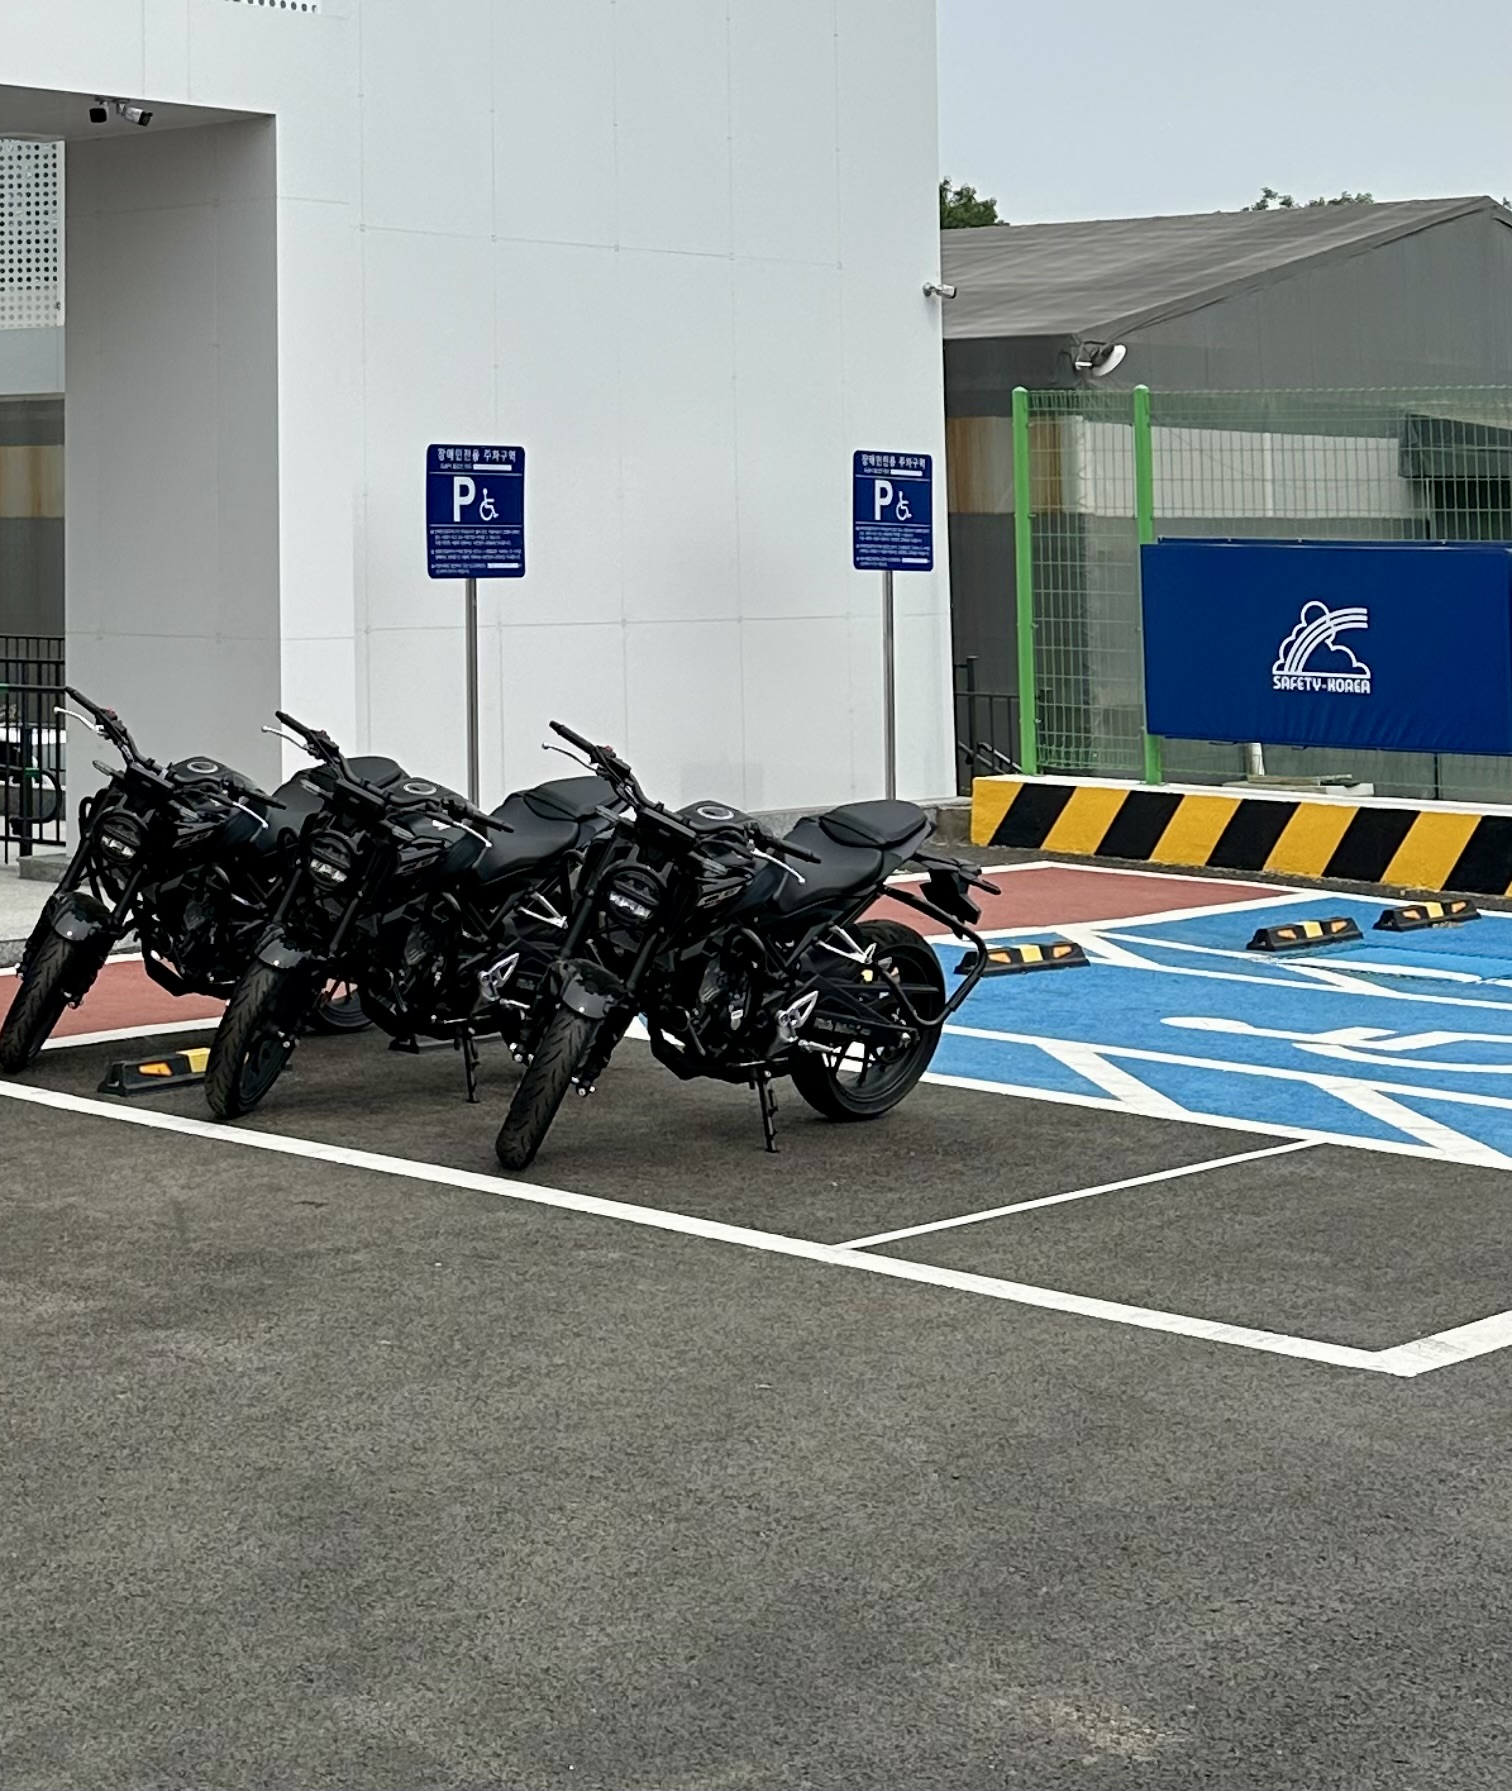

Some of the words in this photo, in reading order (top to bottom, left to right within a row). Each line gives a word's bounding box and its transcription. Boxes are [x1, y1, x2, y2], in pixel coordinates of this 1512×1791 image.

[453, 476, 476, 522] P
[874, 479, 893, 521] P
[1272, 675, 1371, 694] SAFETY-KOREA
